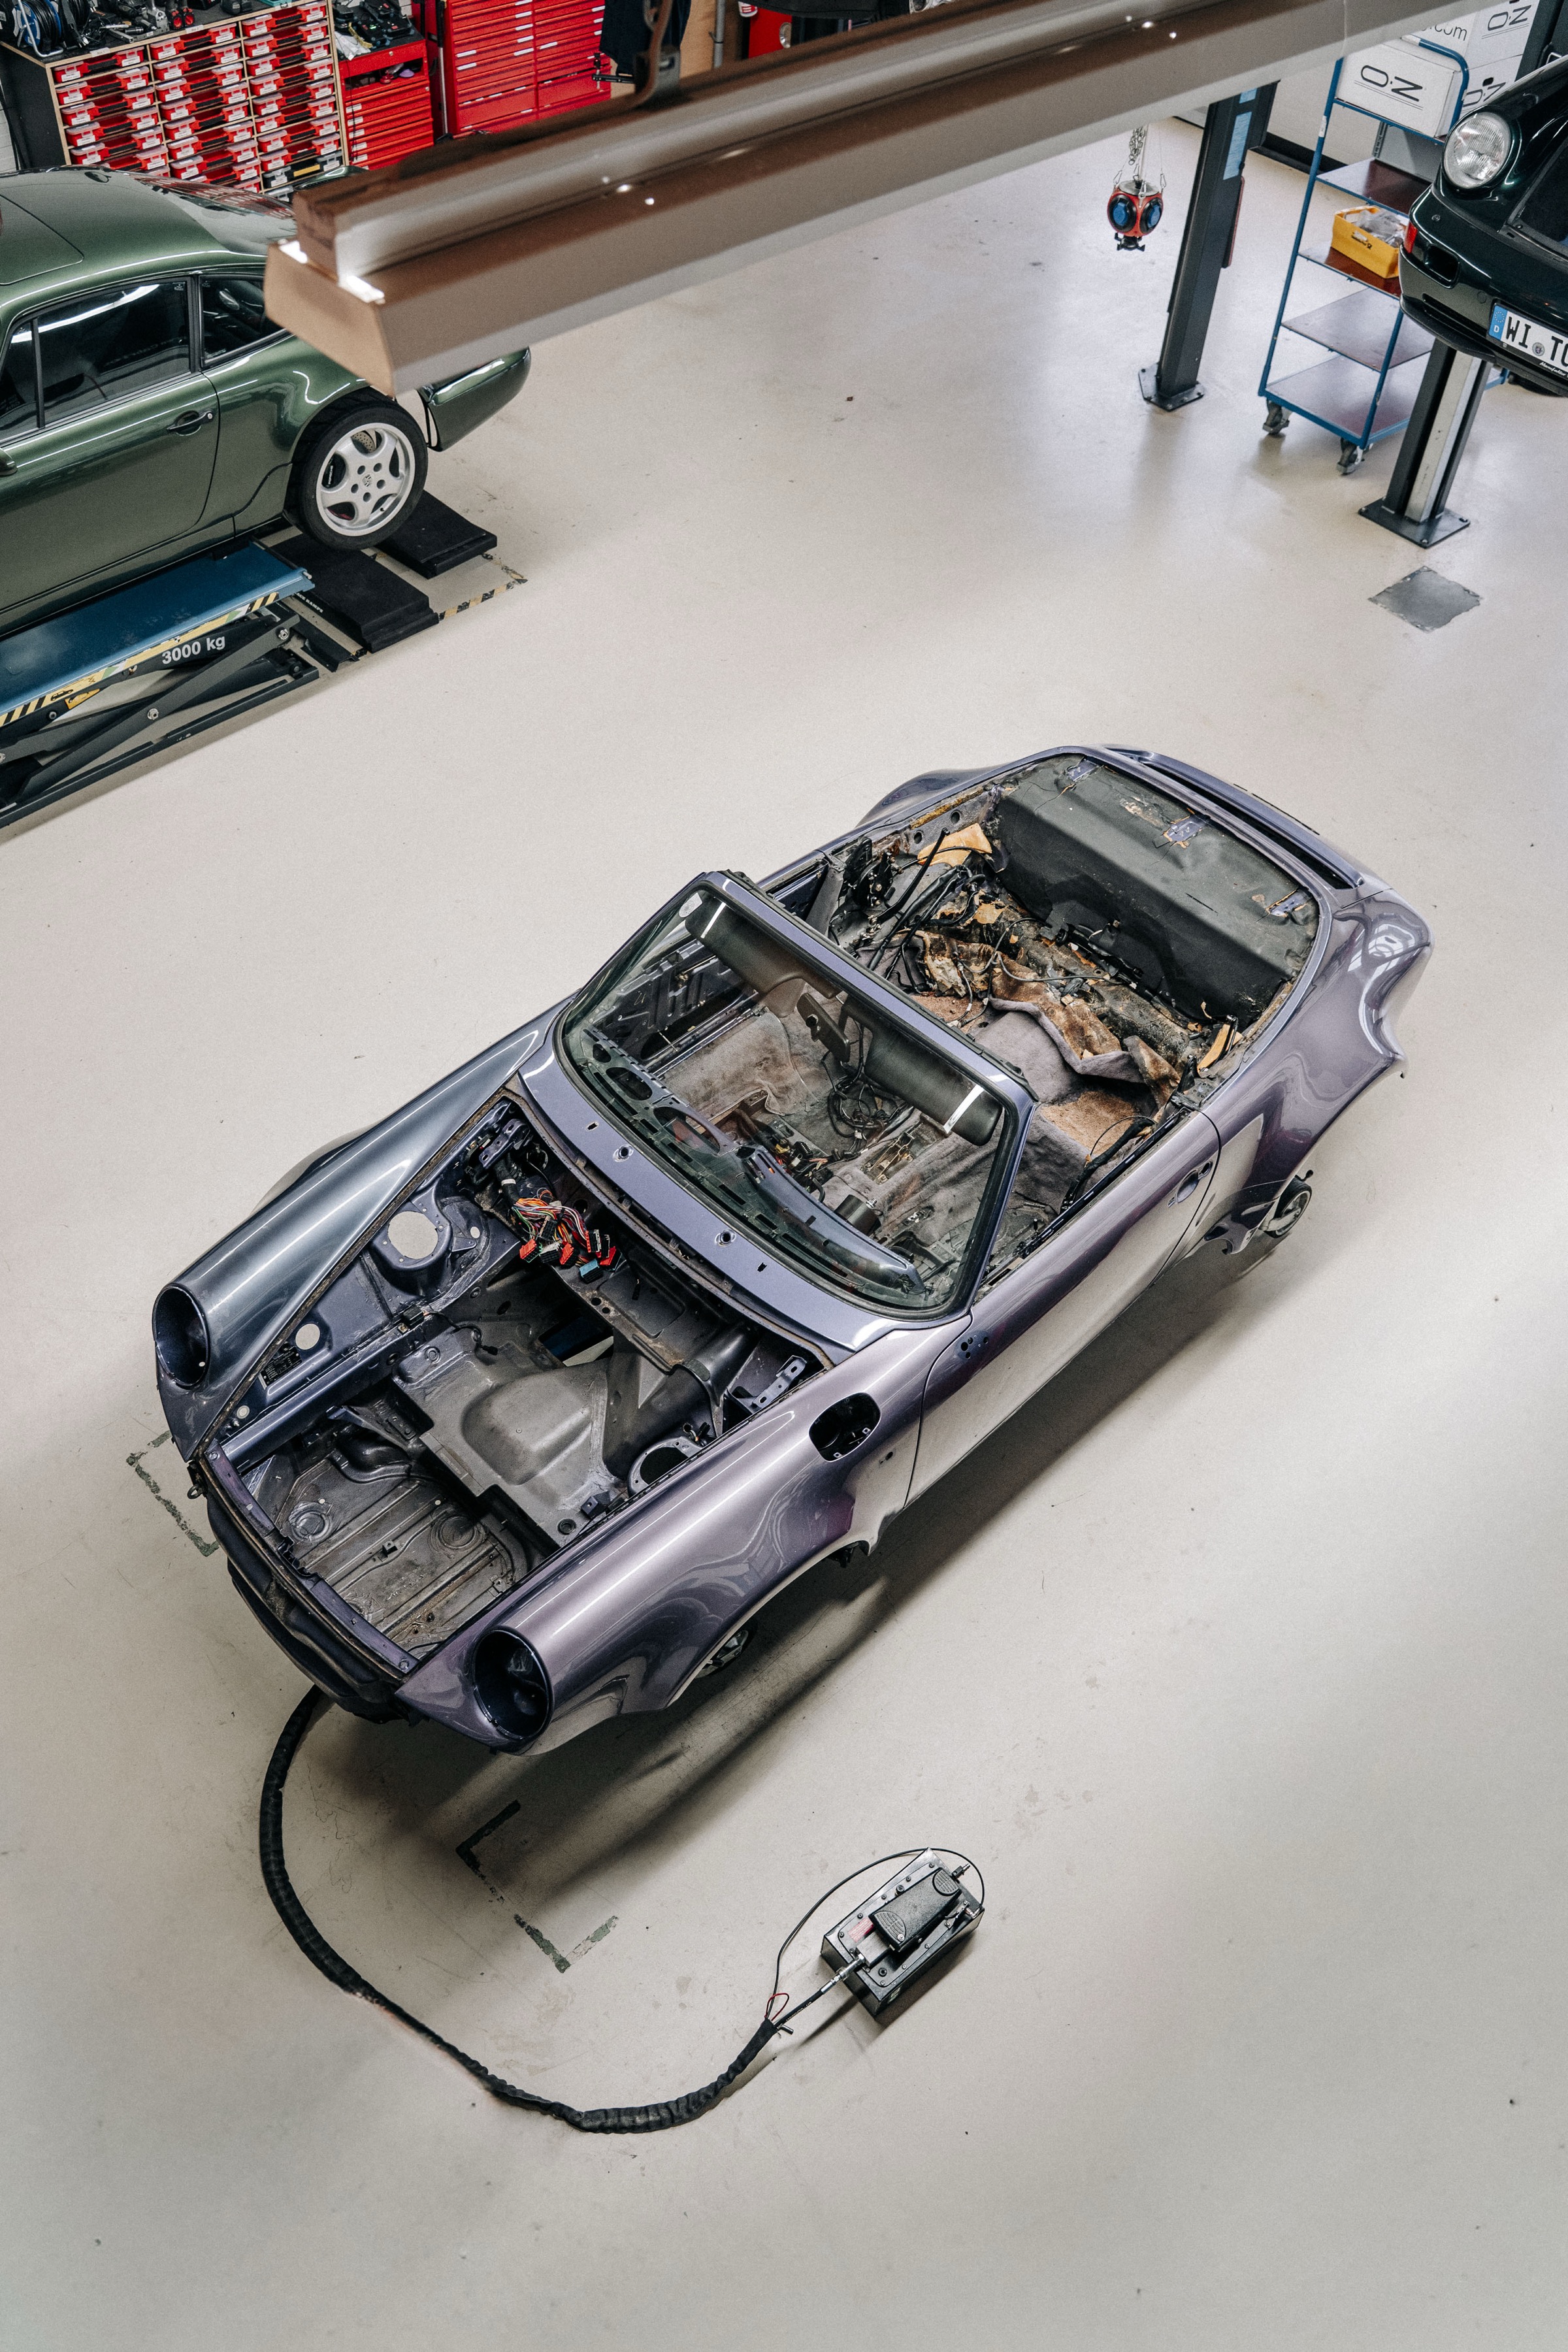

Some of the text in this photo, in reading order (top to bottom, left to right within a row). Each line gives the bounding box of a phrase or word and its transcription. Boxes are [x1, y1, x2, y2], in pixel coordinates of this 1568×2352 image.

[1493, 325, 1500, 333] D
[1506, 316, 1531, 349] WI
[161, 636, 225, 664] 3000 kg
